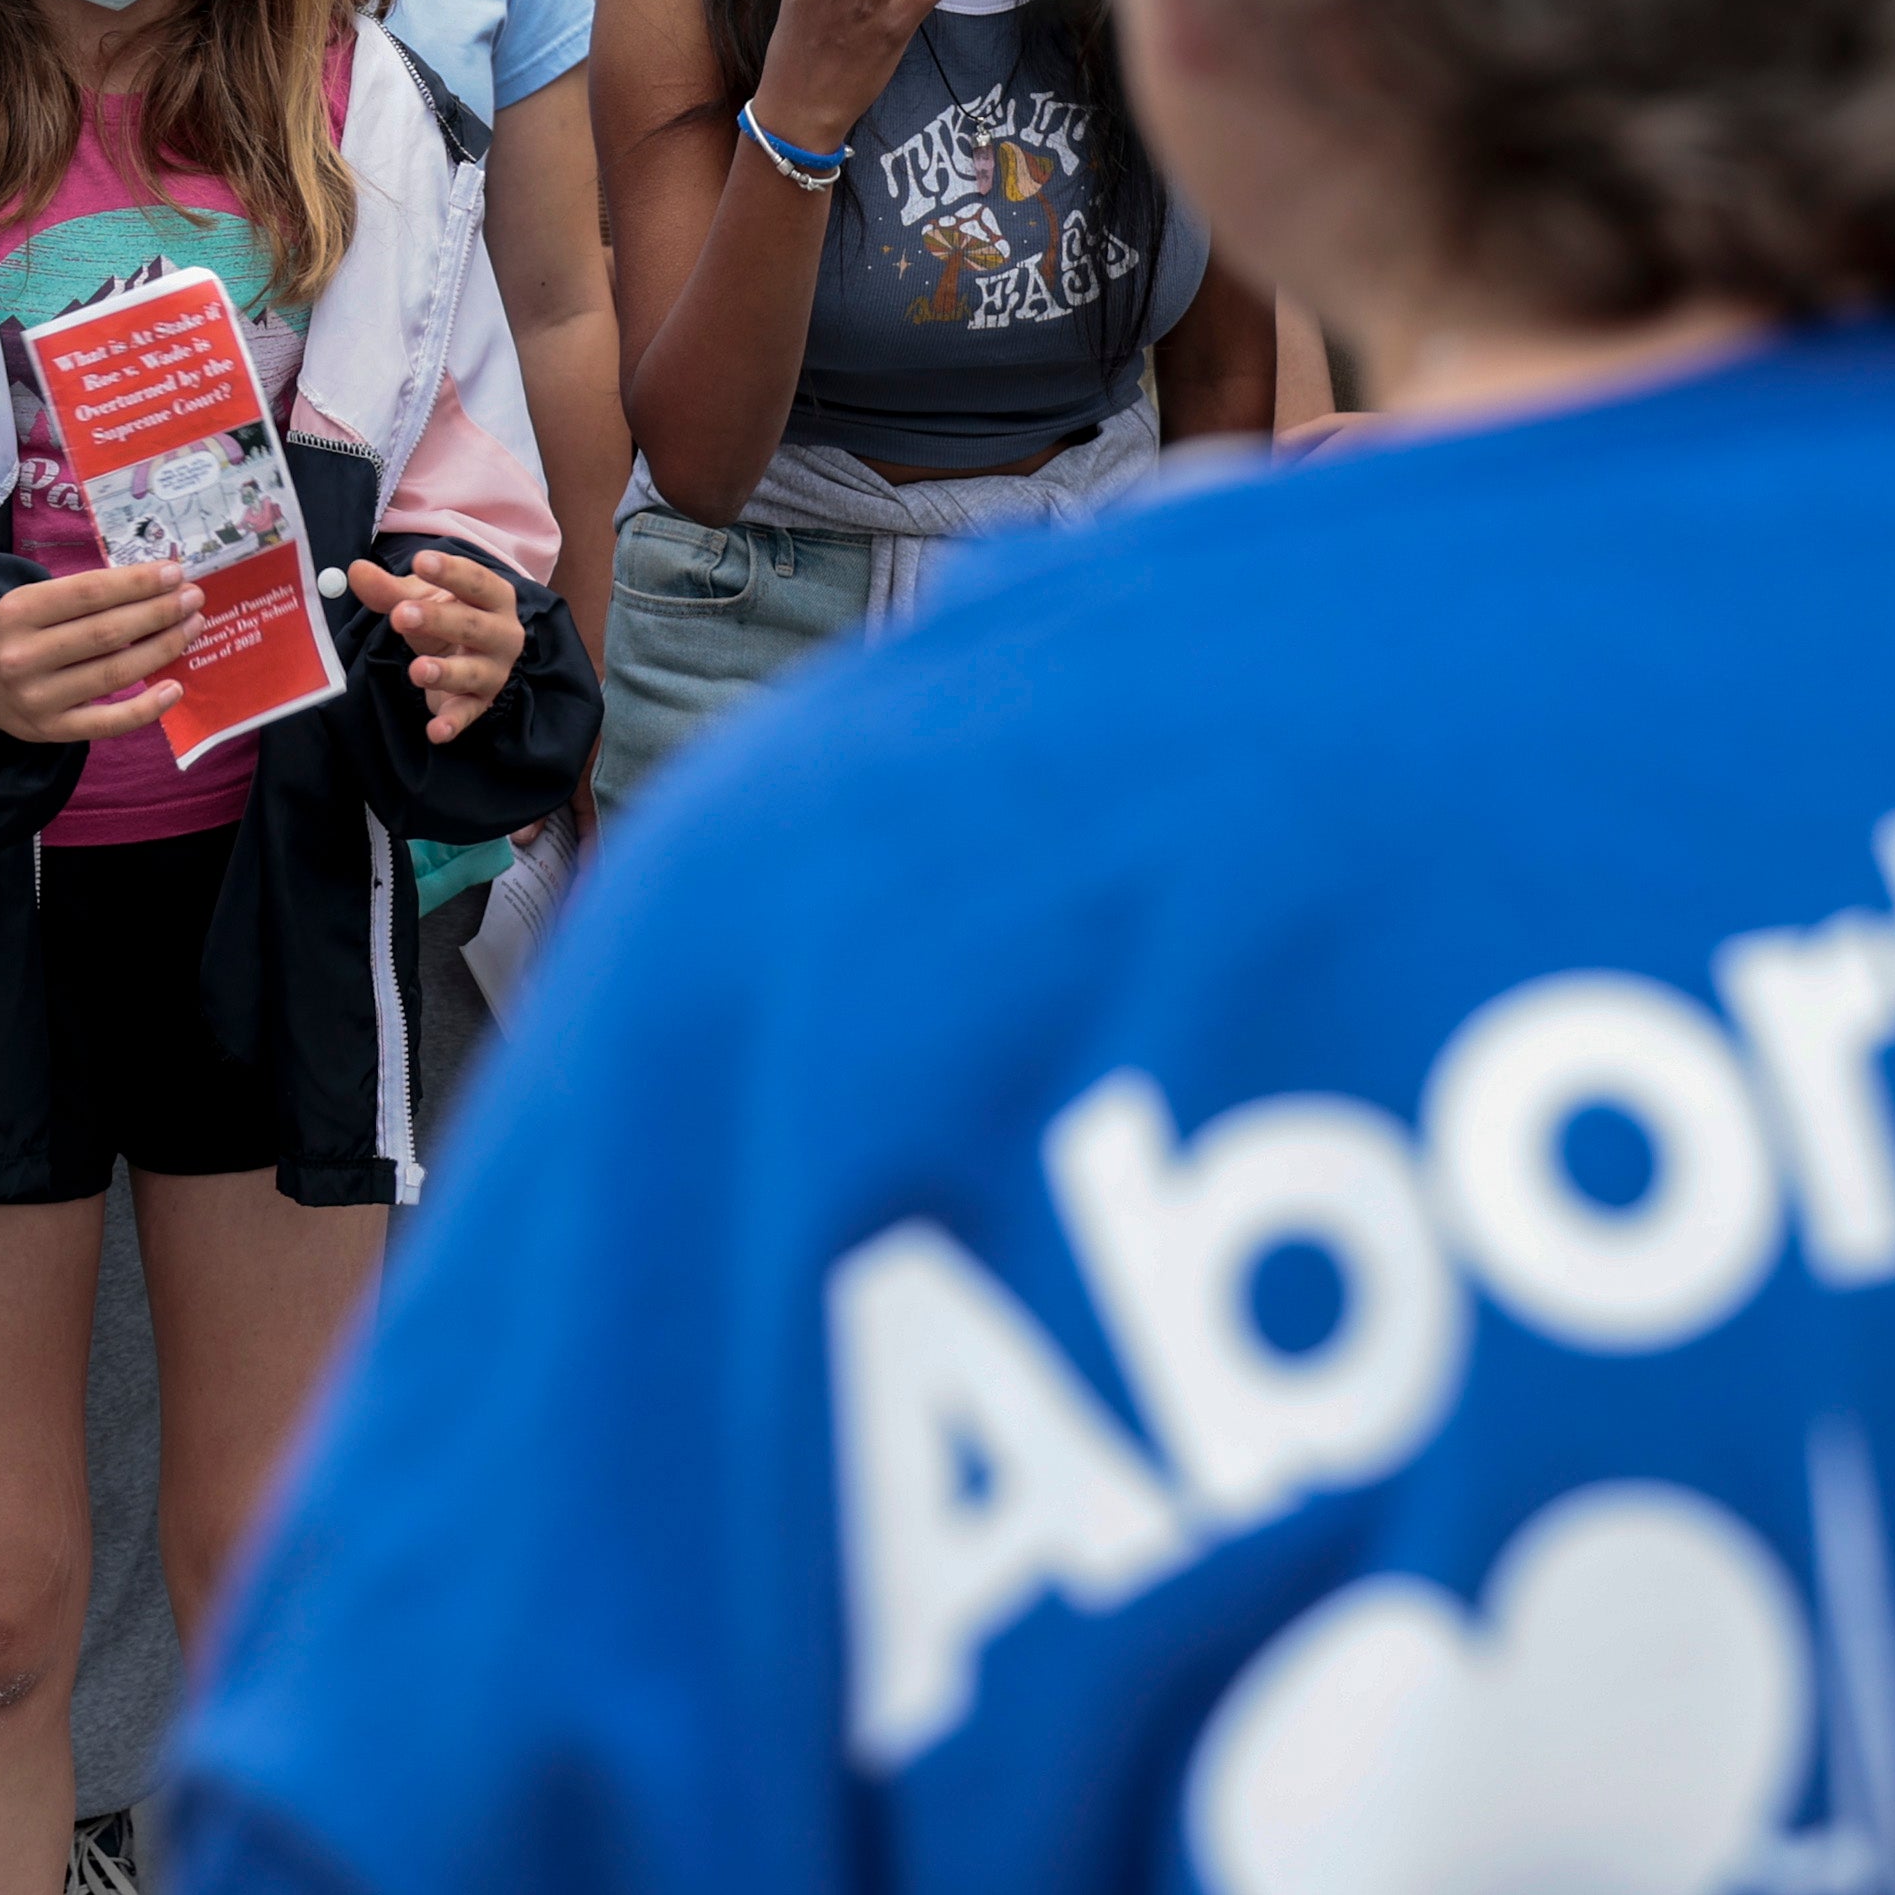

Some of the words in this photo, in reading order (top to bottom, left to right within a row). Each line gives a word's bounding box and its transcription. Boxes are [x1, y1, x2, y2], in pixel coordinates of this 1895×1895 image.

[880, 83, 1016, 227] TAKE
[1019, 90, 1090, 176] IT
[52, 347, 108, 372] What
[108, 339, 128, 354] is
[130, 331, 154, 348] At
[153, 313, 205, 339] Stake
[203, 301, 222, 321] if
[81, 371, 123, 392] Roe
[139, 343, 193, 369] Wade
[191, 337, 213, 353] is
[75, 374, 178, 422] Overturned
[176, 370, 202, 389] by
[202, 358, 235, 377] the
[91, 409, 173, 445] Supreme
[172, 382, 232, 416] Court?
[204, 604, 240, 631] tional
[240, 584, 294, 614] Pamphlet
[236, 615, 260, 633] Day
[260, 595, 299, 622] School
[189, 652, 218, 671] Class
[219, 641, 233, 659] of
[234, 628, 263, 653] 2022
